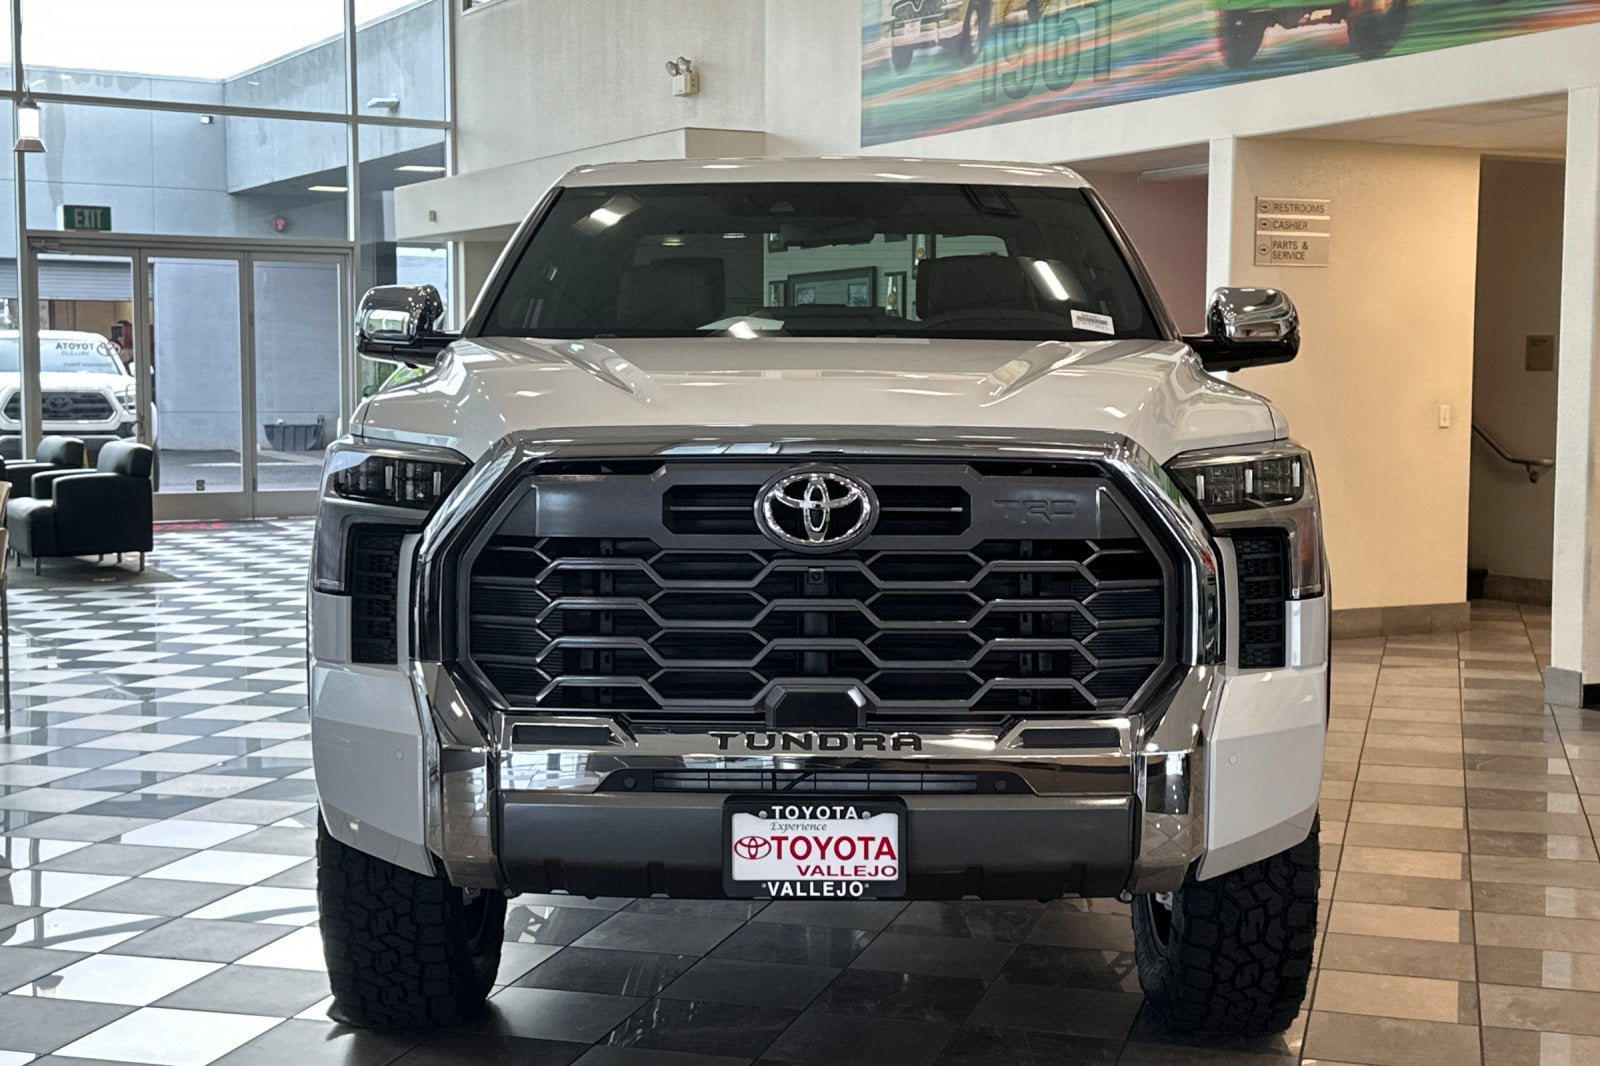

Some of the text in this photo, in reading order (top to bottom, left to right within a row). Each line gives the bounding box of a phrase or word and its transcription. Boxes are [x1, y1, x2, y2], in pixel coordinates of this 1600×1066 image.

[1272, 203, 1325, 213] RESTROOMS
[74, 207, 103, 229] EXIT
[1272, 220, 1308, 230] CASHIER
[1272, 240, 1309, 250] PARTS &
[1272, 250, 1306, 260] SERVICE
[993, 500, 1077, 522] TRD
[708, 731, 923, 751] TUNDRA
[771, 805, 859, 820] TOYOTA
[770, 821, 828, 833] Experience
[770, 836, 897, 861] TOYOTA
[796, 865, 898, 877] VALLEJO
[767, 881, 864, 897] VALLEJO
